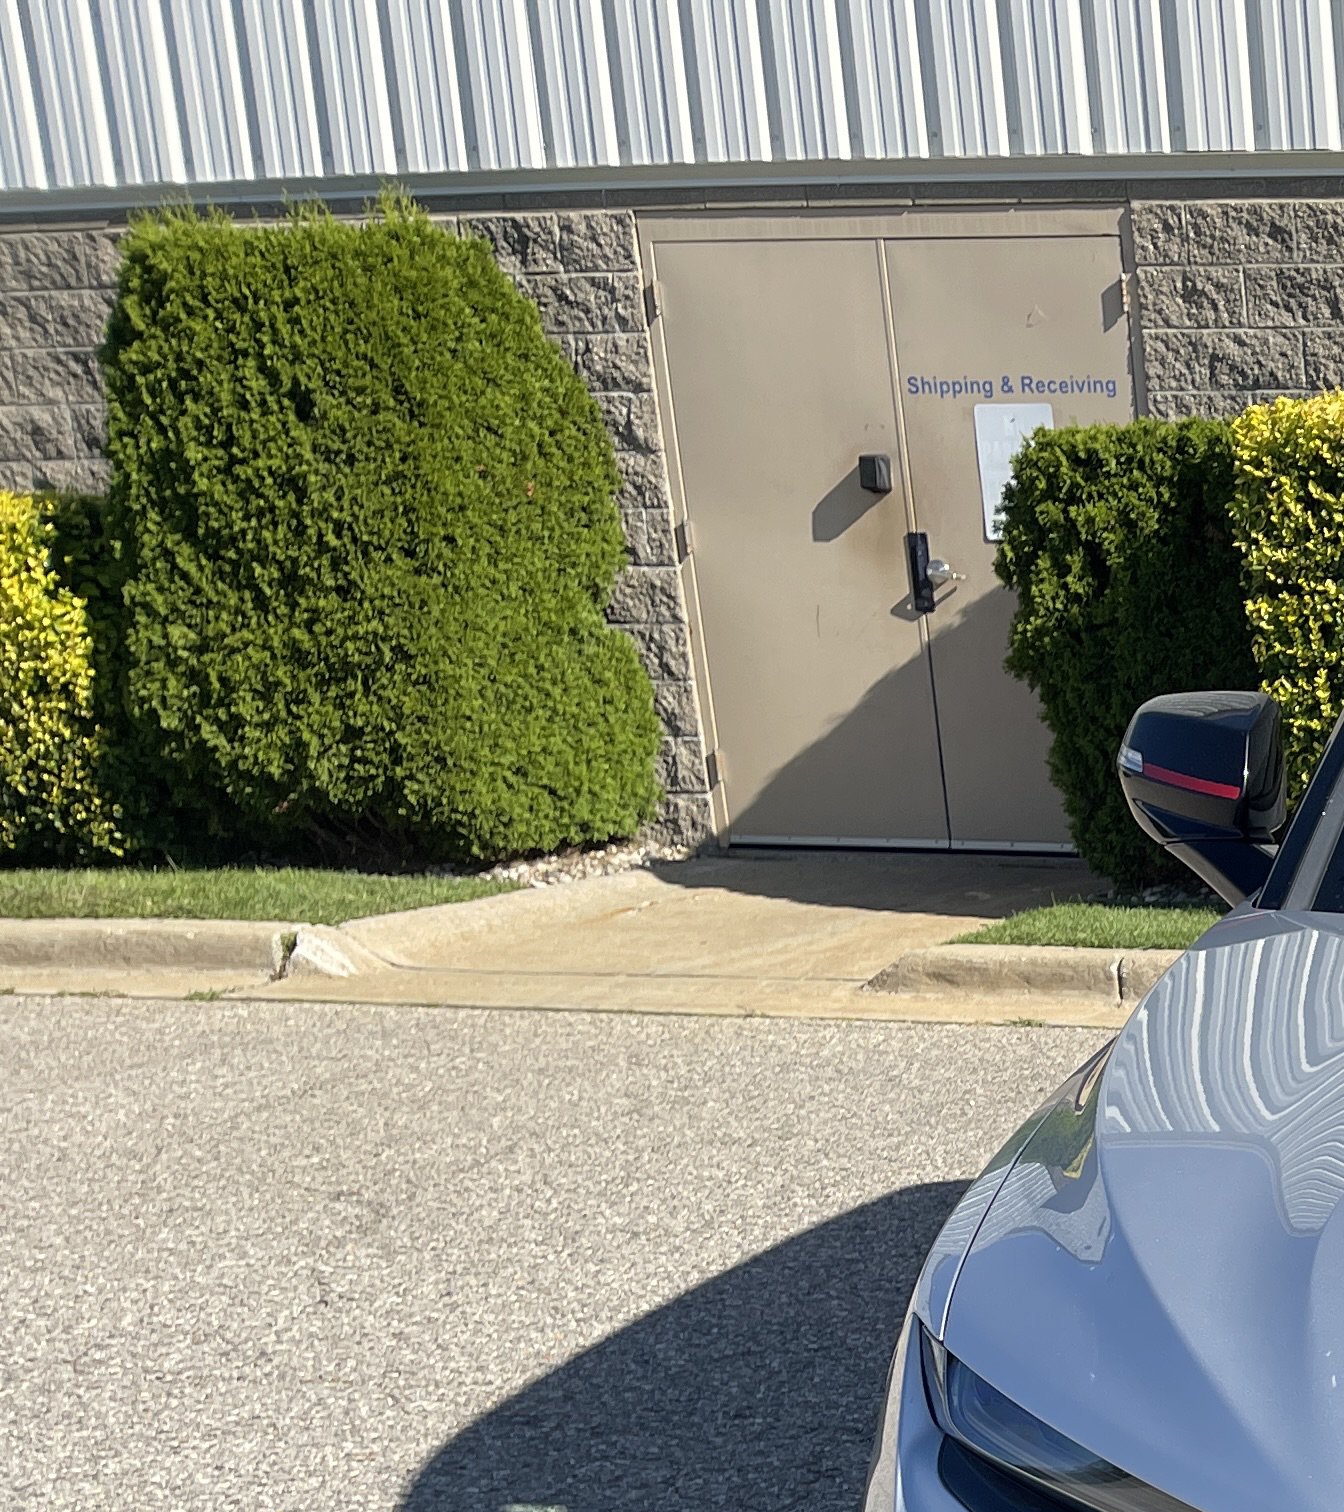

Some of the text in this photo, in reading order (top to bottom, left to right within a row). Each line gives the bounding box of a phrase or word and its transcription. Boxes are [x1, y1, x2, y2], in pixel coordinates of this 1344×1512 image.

[907, 375, 1117, 398] Shipping & Receiving
